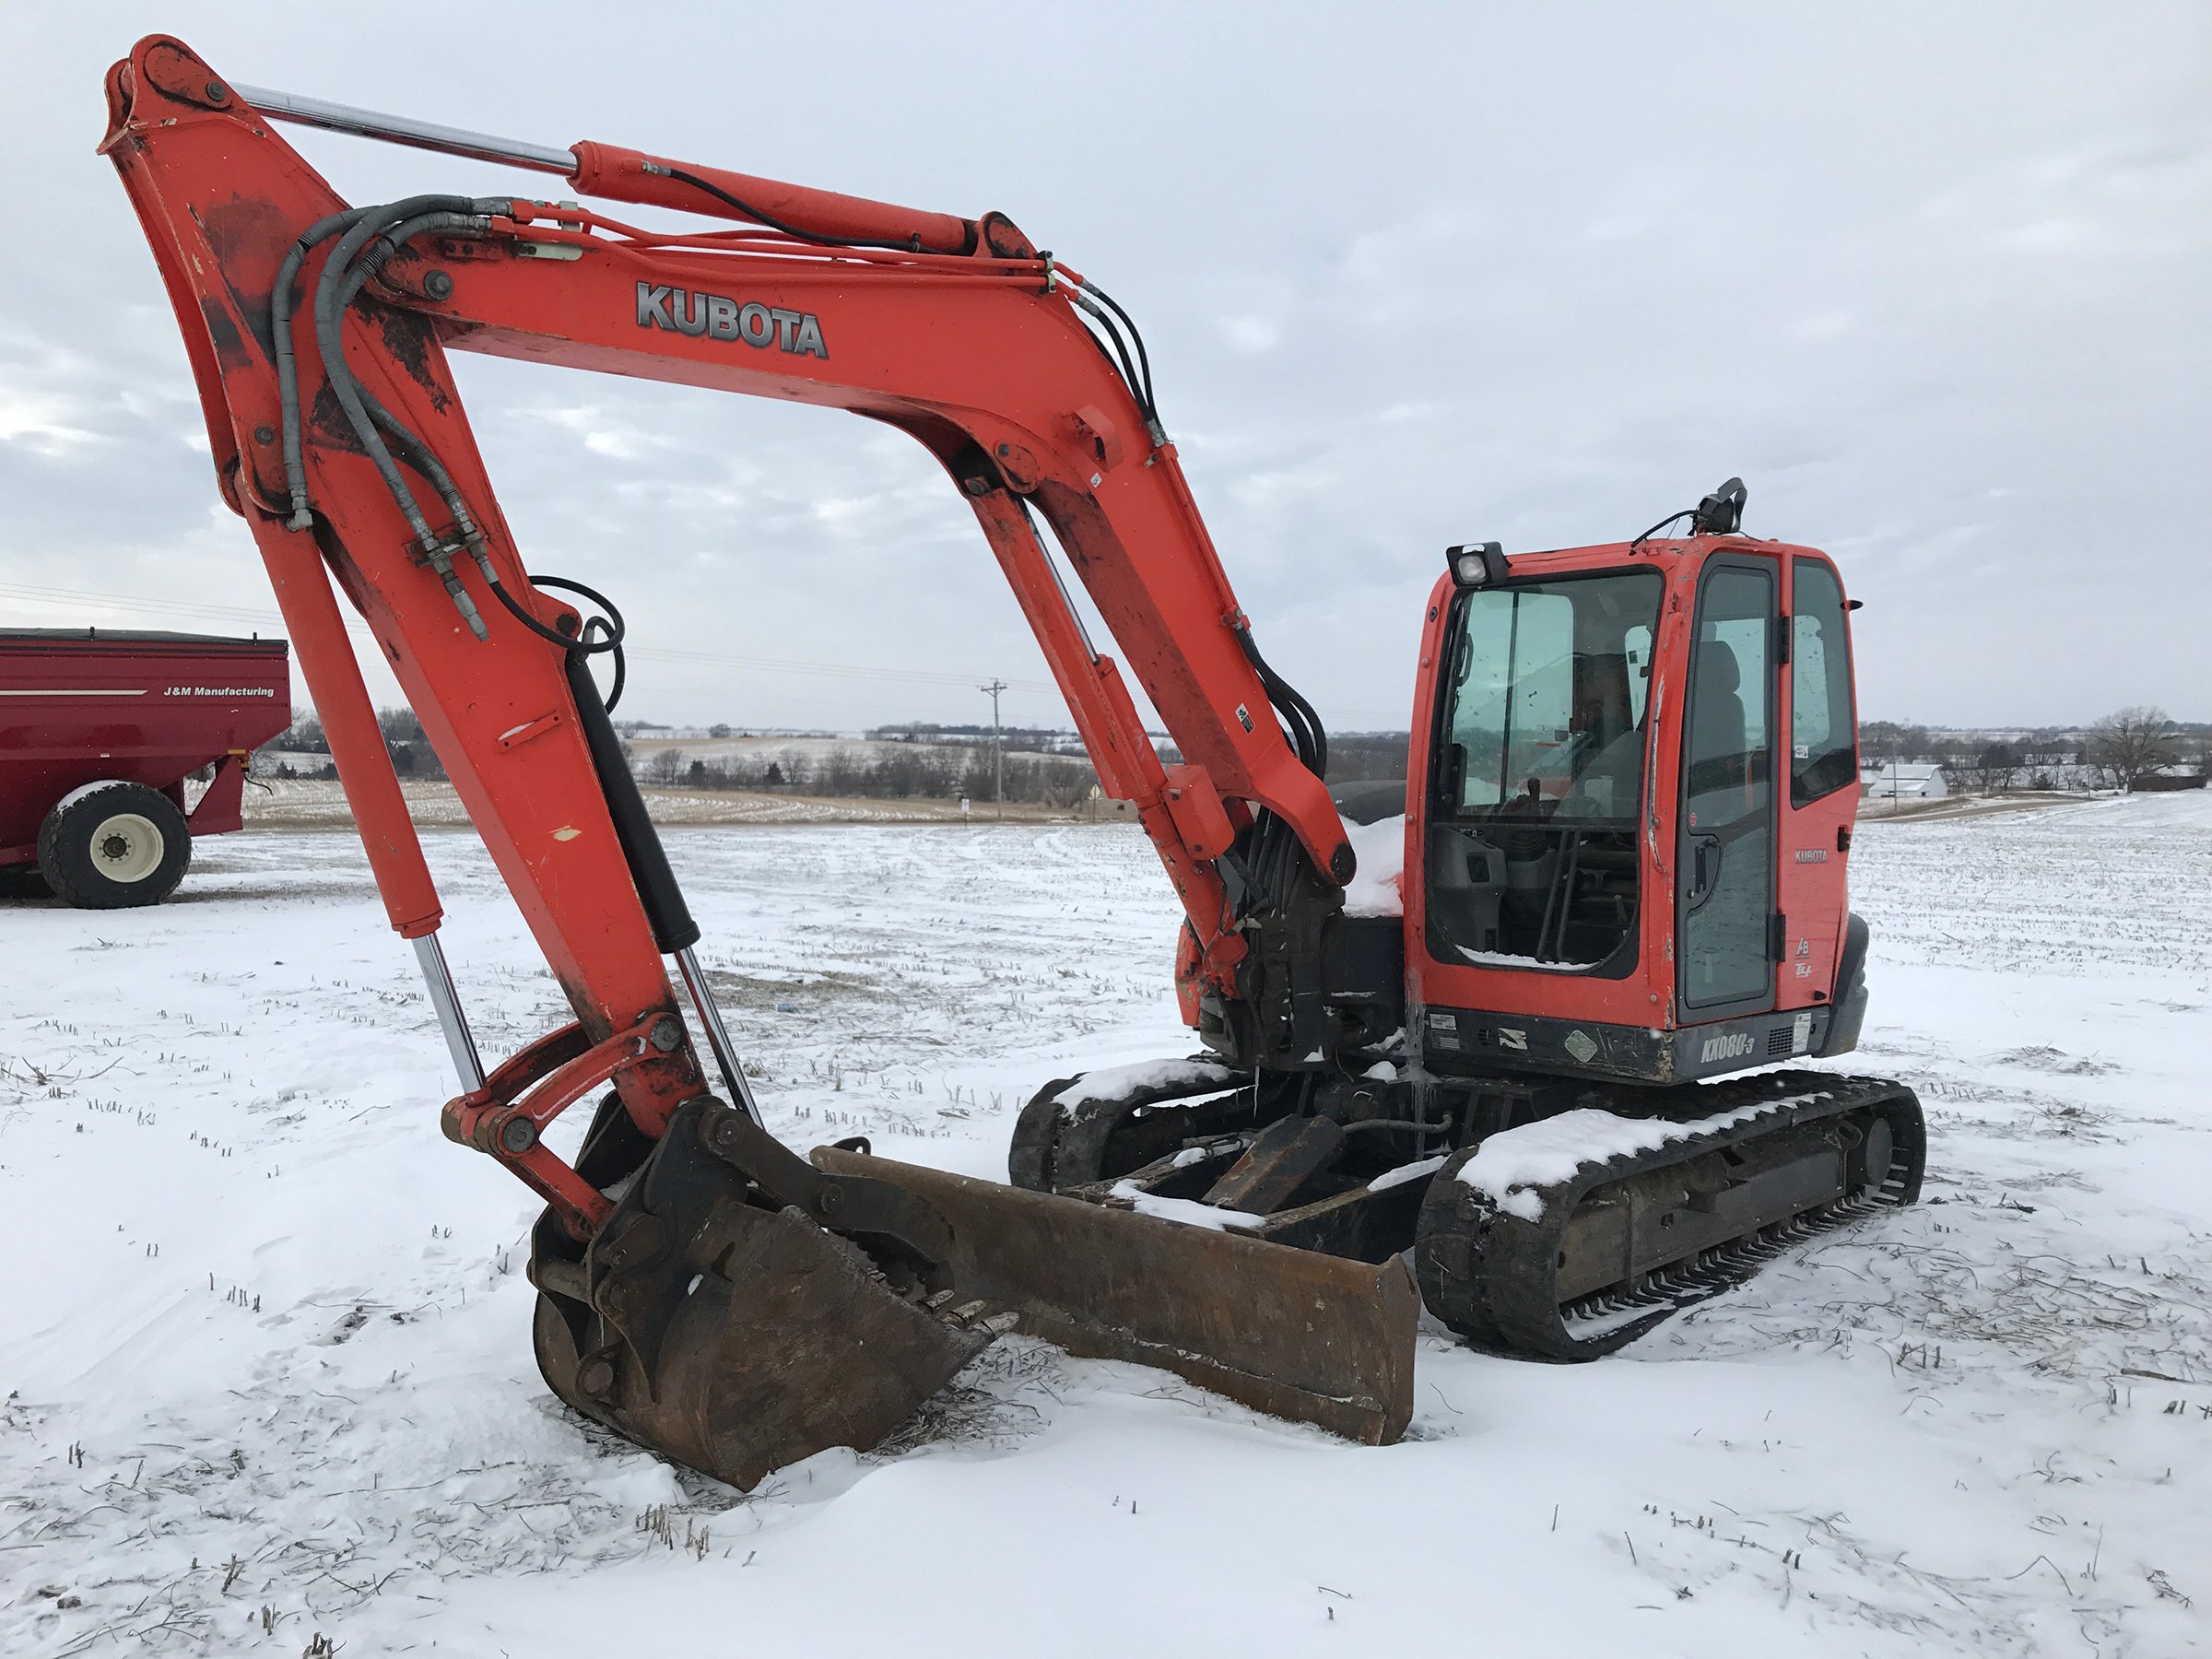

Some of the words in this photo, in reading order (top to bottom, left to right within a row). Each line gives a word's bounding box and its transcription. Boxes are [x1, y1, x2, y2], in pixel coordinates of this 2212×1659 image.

[637, 281, 828, 359] KUBOTA
[163, 687, 192, 696] J&M
[194, 687, 274, 697] Manufacturing
[1795, 849, 1828, 864] KUBOTA
[1700, 1033, 1755, 1064] KX080-3
